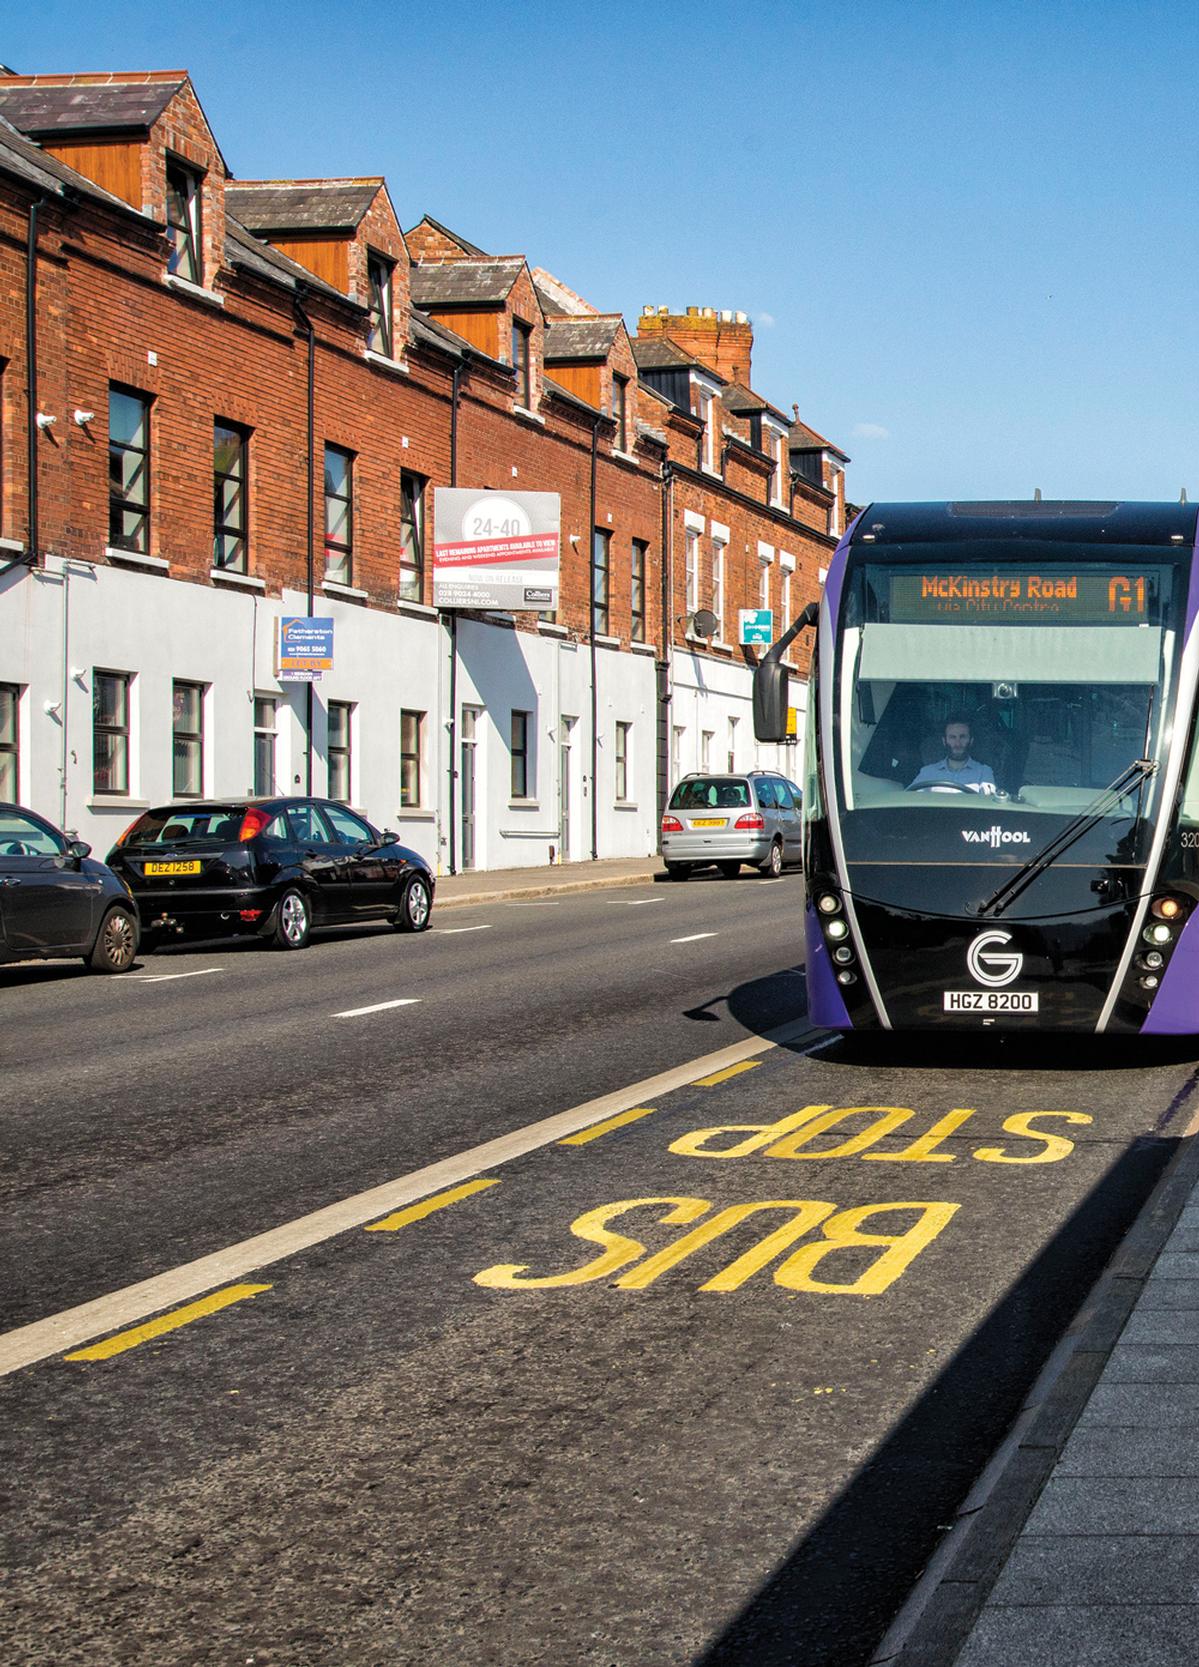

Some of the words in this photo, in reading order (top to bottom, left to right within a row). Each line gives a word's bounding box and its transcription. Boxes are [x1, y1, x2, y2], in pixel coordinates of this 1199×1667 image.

[473, 517, 520, 536] 24-40
[436, 549, 449, 557] LAST
[449, 547, 476, 556] REMAINING
[477, 544, 509, 553] APARTMENTS
[510, 541, 535, 550] AVAILABLE
[543, 539, 556, 547] VIEW
[496, 549, 532, 557] APPOINTMENTS
[497, 575, 523, 583] RELEASE
[921, 576, 1020, 599] McKinstry
[1027, 576, 1077, 598] Road
[1108, 576, 1145, 612] G1
[950, 994, 983, 1010] HGZ
[987, 994, 1032, 1010] 8200
[667, 1105, 1094, 1165] STOP
[472, 1196, 963, 1296] BUS
